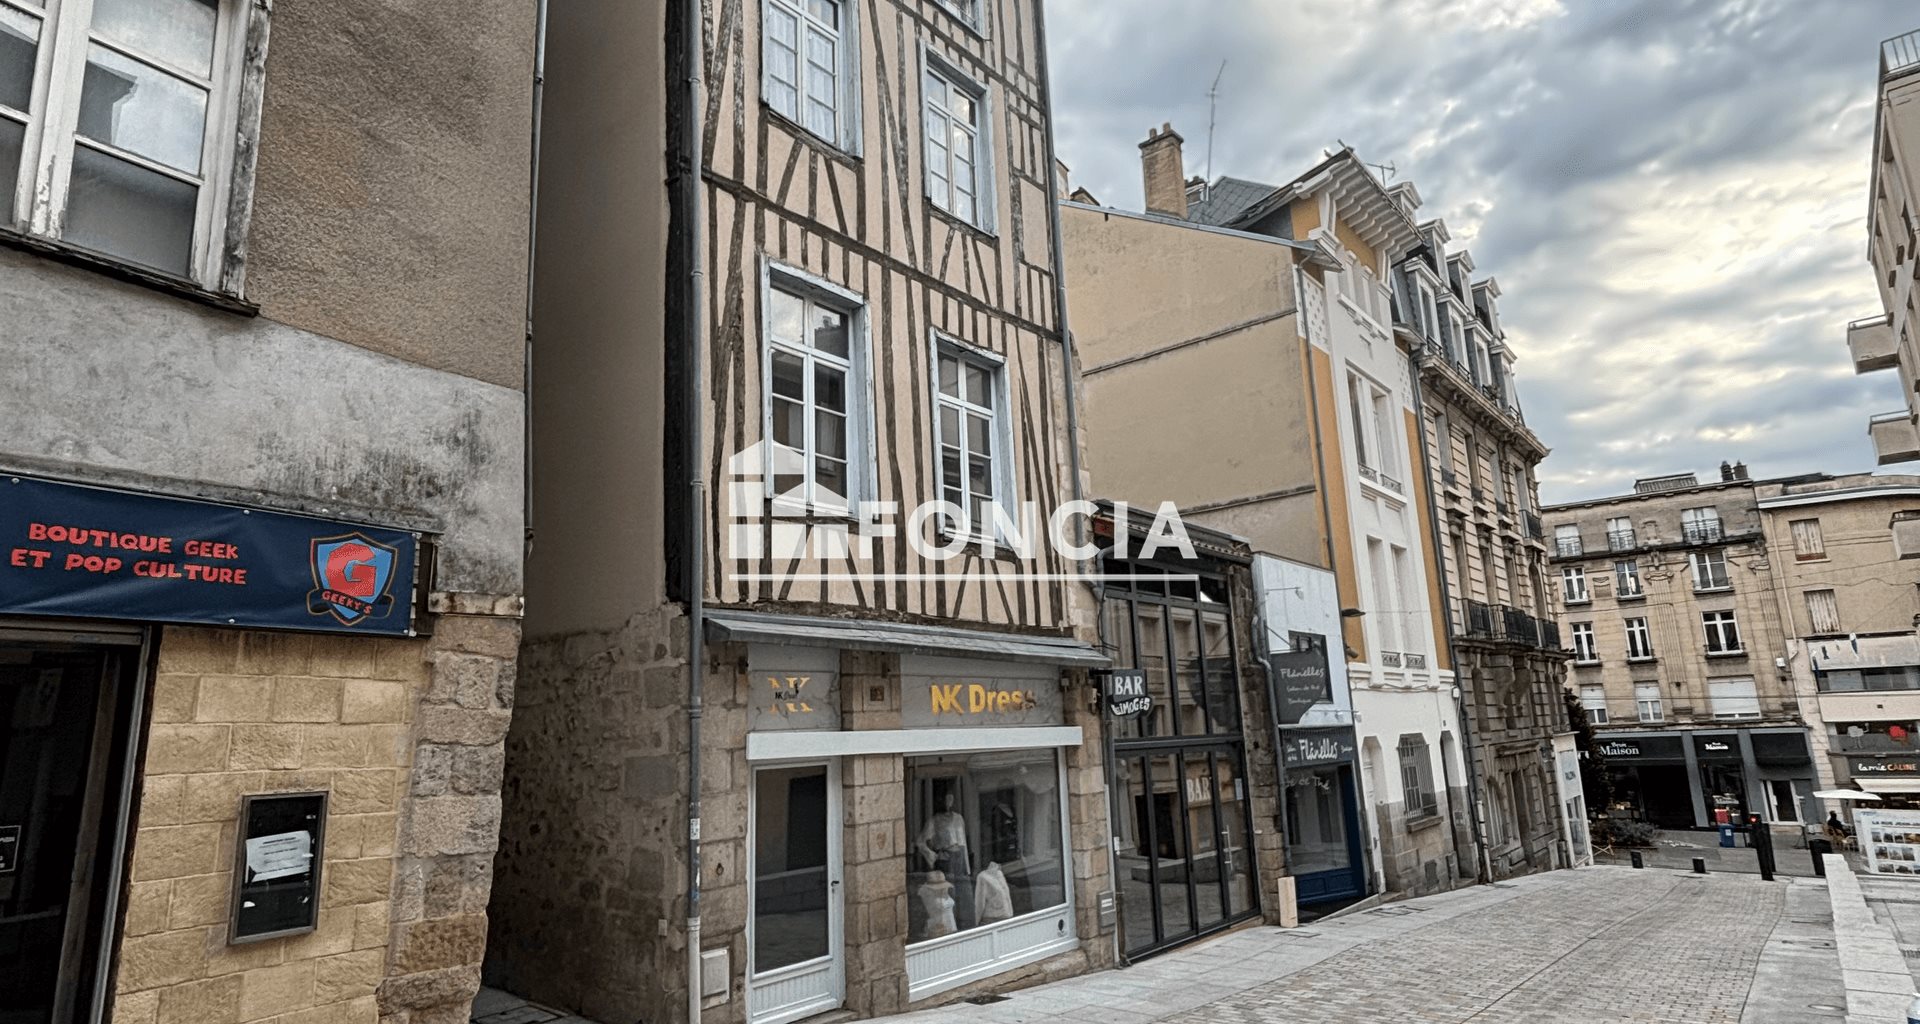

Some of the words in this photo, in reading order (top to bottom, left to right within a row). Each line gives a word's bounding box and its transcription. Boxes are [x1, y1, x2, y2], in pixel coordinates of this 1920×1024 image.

[28, 523, 172, 553] BOUTIQUE
[184, 540, 239, 559] GEEK
[11, 549, 50, 568] ET
[64, 553, 122, 574] POP
[133, 560, 247, 584] CULTURE
[325, 543, 376, 597] G
[321, 590, 373, 614] GEEKY'S
[930, 683, 965, 716] NK
[968, 683, 1037, 714] Dress
[1114, 675, 1144, 695] BAR
[1599, 744, 1640, 756] Maison
[1186, 777, 1211, 802] BAR
